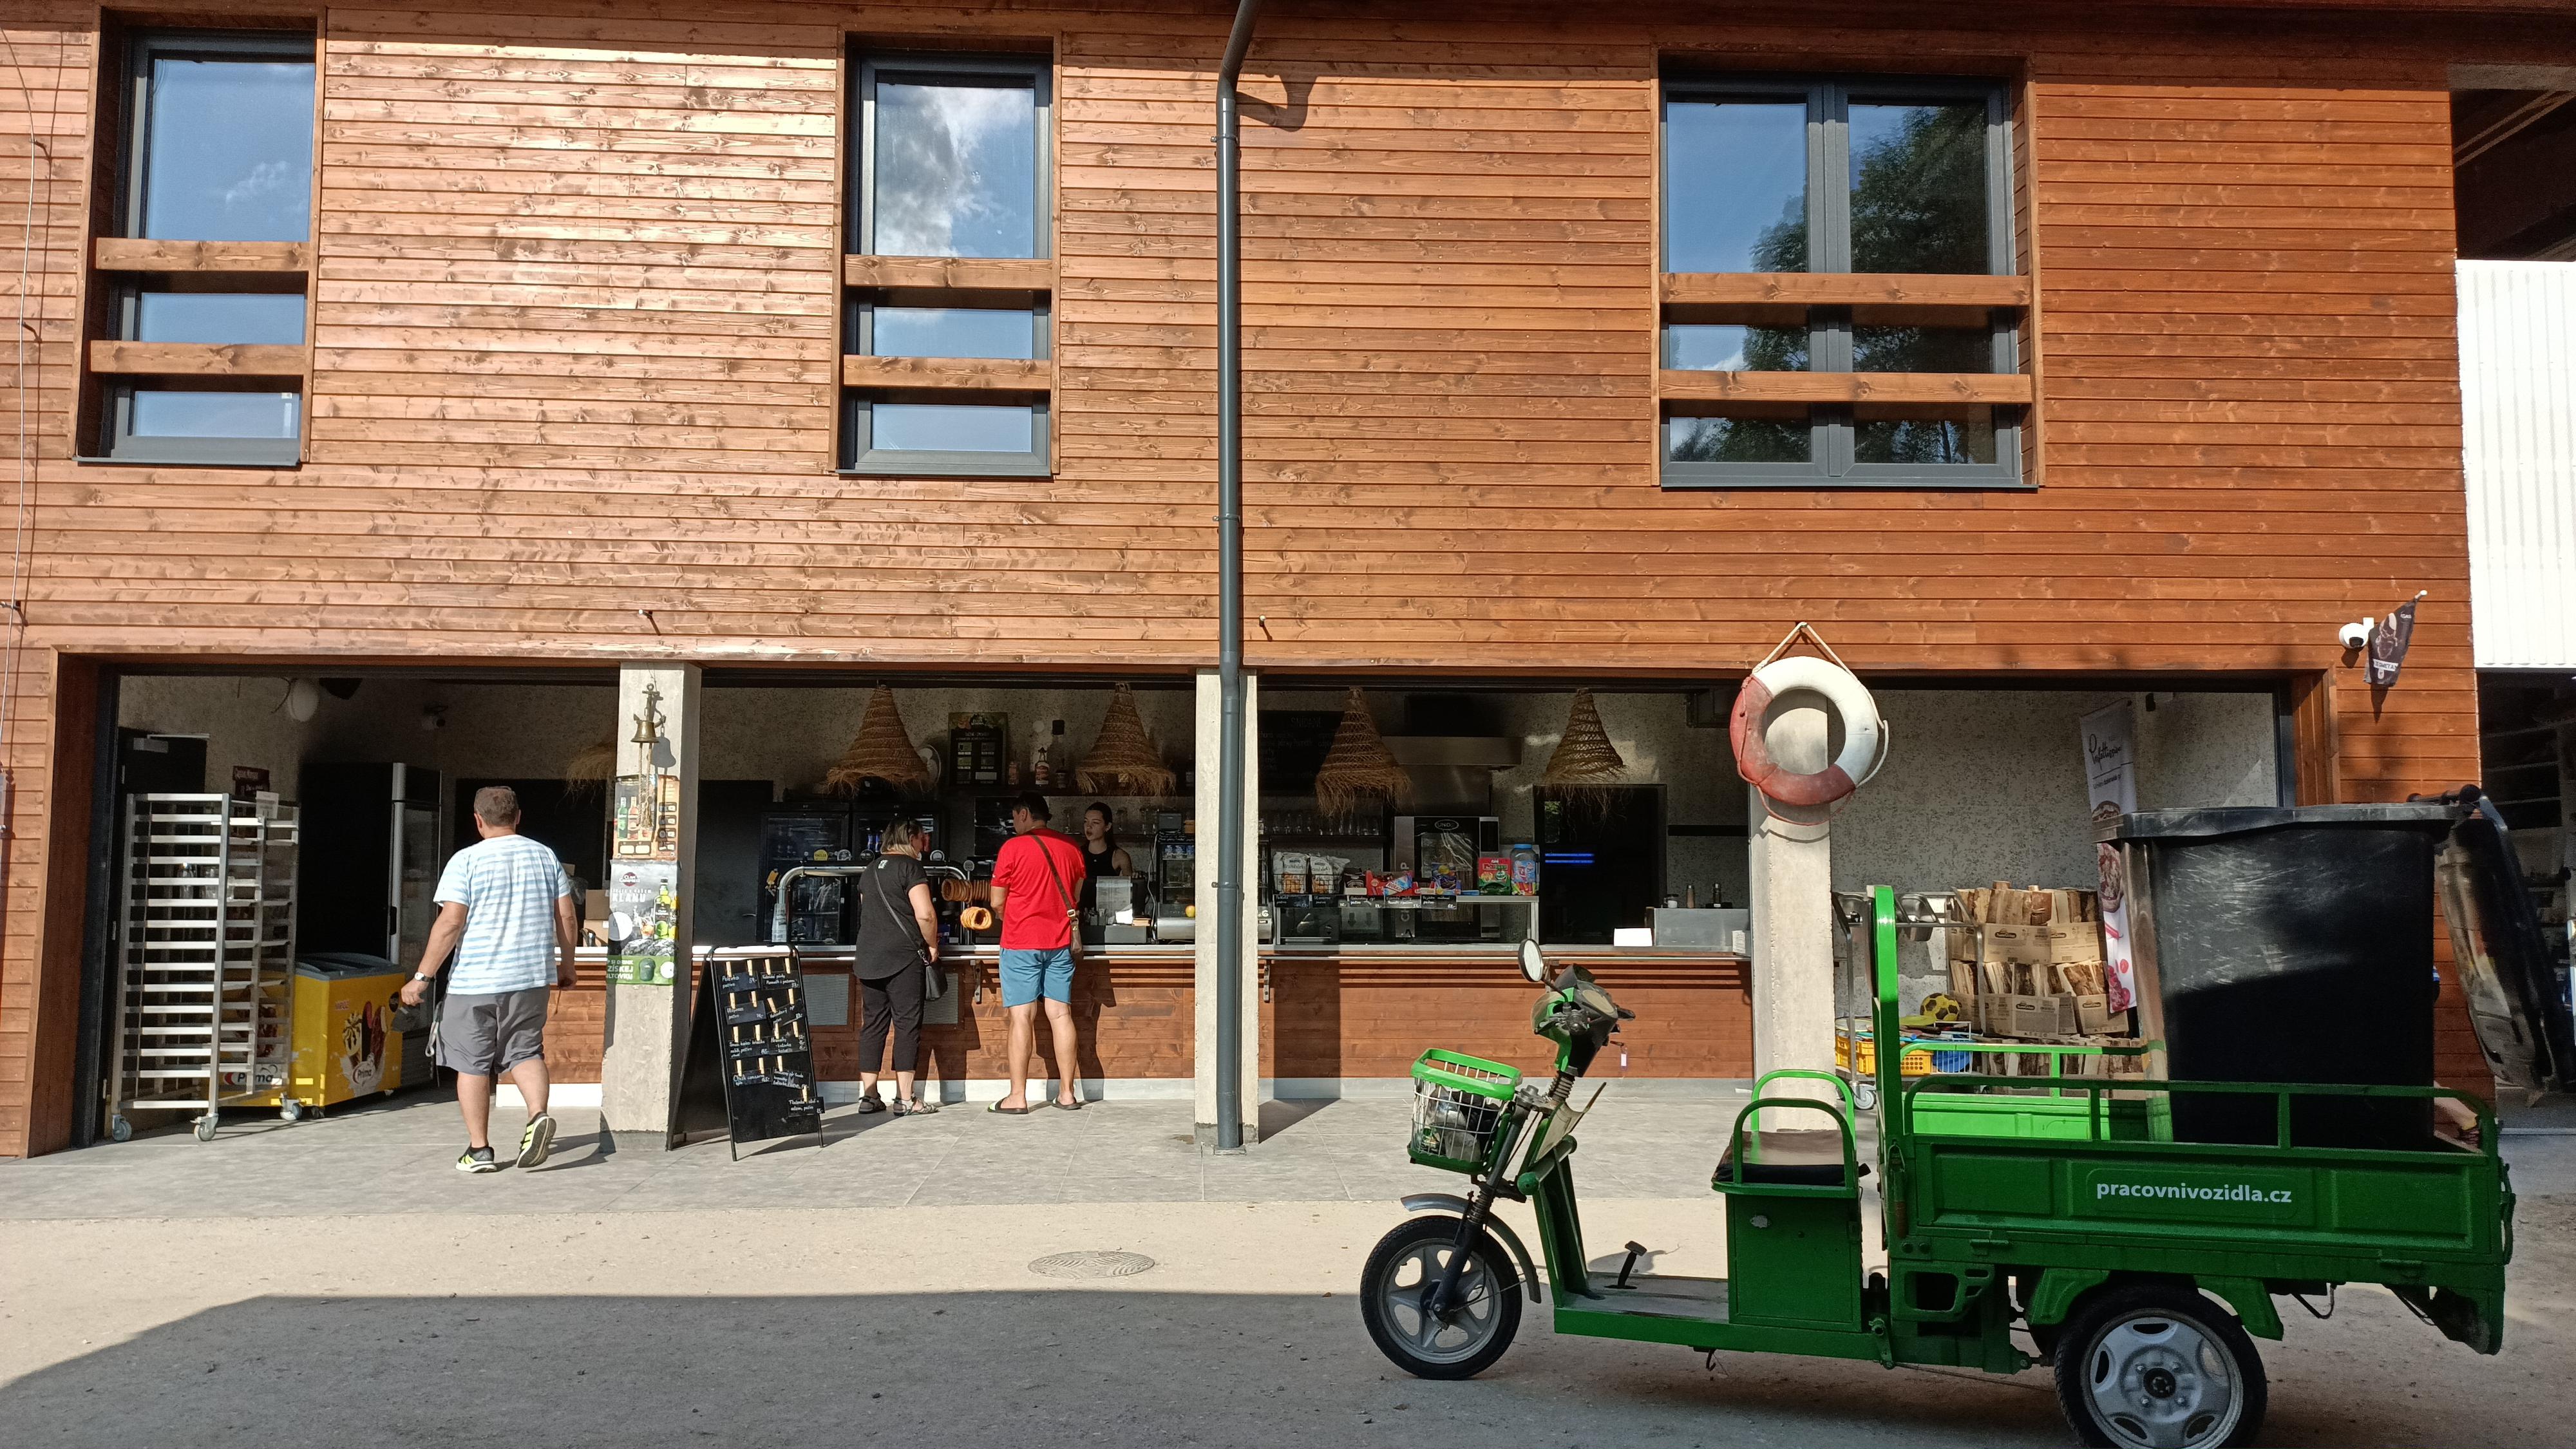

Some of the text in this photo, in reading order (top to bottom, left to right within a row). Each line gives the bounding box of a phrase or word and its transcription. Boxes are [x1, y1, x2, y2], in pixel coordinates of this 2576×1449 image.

[612, 893, 646, 902] KLANU
[238, 1073, 273, 1083] Pma
[357, 1068, 372, 1078] Prima
[2097, 1182, 2292, 1203] pracovnivozidla.cz
